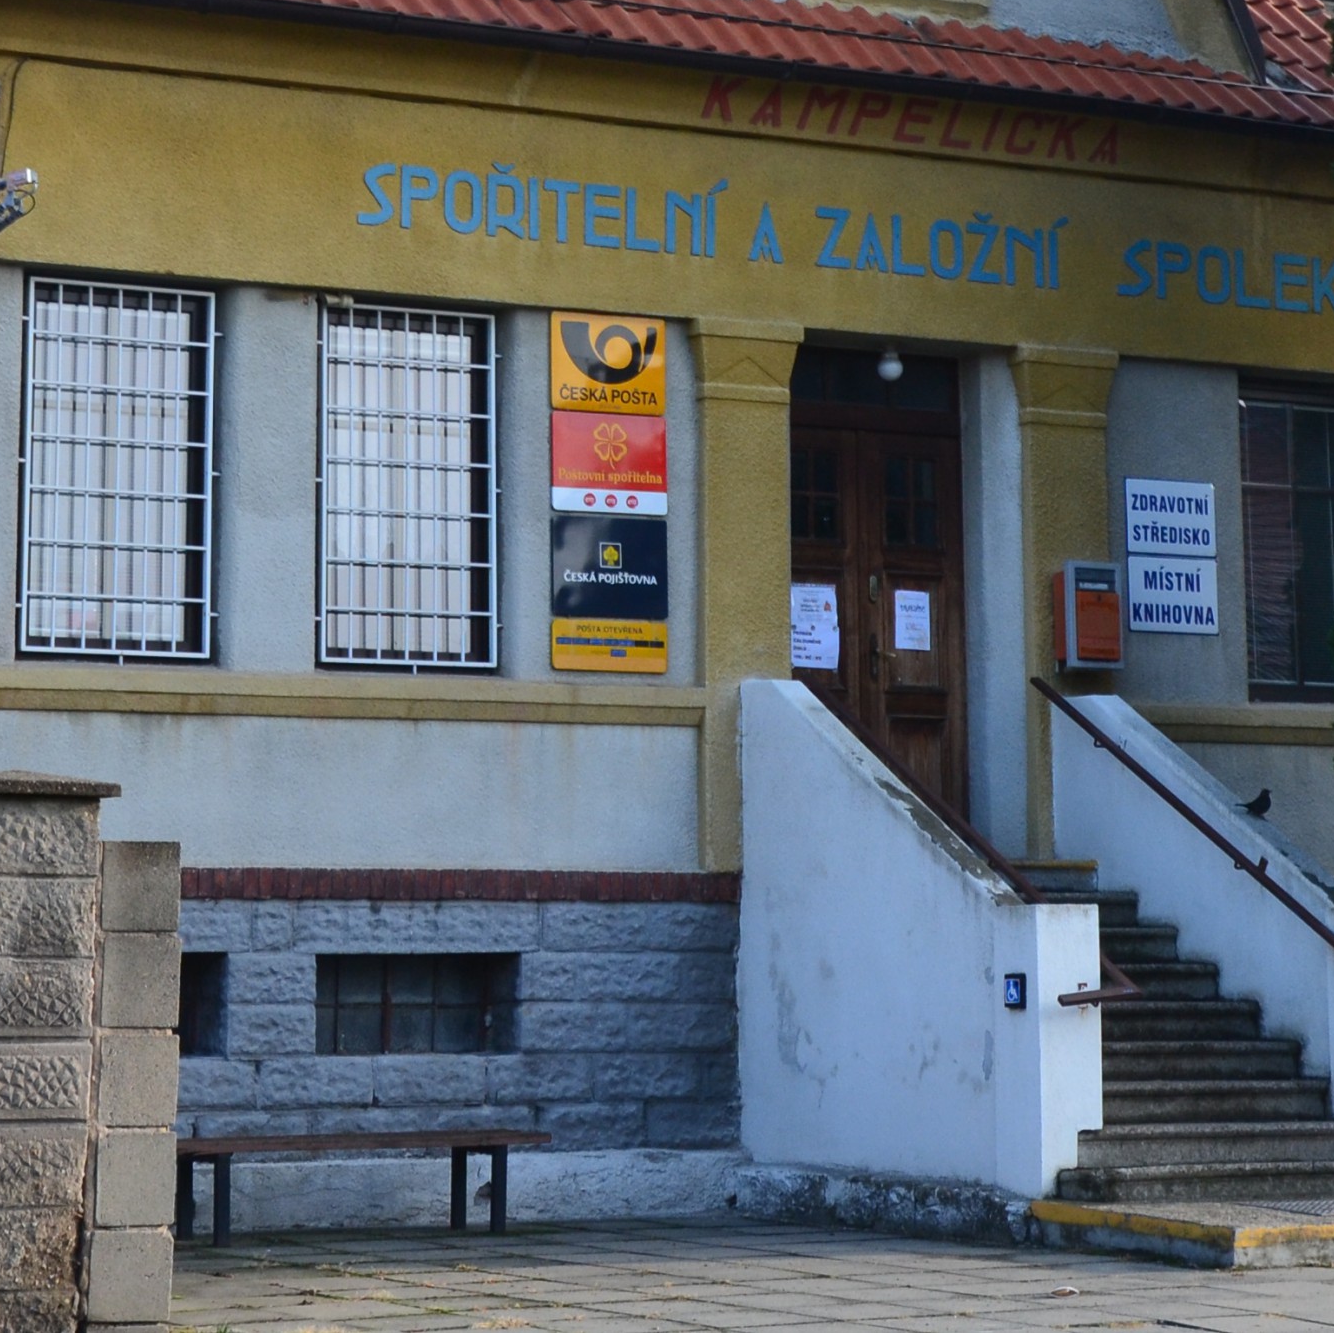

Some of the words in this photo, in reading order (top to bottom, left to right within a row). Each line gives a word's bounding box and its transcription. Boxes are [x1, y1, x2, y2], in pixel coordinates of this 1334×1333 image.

[357, 160, 728, 257] SPOŘITELNÍ
[748, 201, 784, 265] A
[815, 204, 1070, 289] ZALOŽNÍ
[559, 384, 608, 402] ČESKÁ
[611, 388, 658, 406] POŠTA
[558, 467, 605, 482] Poštovní
[608, 469, 662, 484] spořitelna
[1131, 494, 1209, 516] ZDRAVOTNÍ
[1133, 520, 1210, 546] STŘEDISKO
[563, 569, 597, 583] ČESKÁ
[598, 570, 658, 586] POJIŠŤOVNA
[1143, 566, 1201, 593] MÍSTNÍ
[1132, 602, 1215, 626] KNIHOVNA
[576, 623, 602, 633] POŠTA
